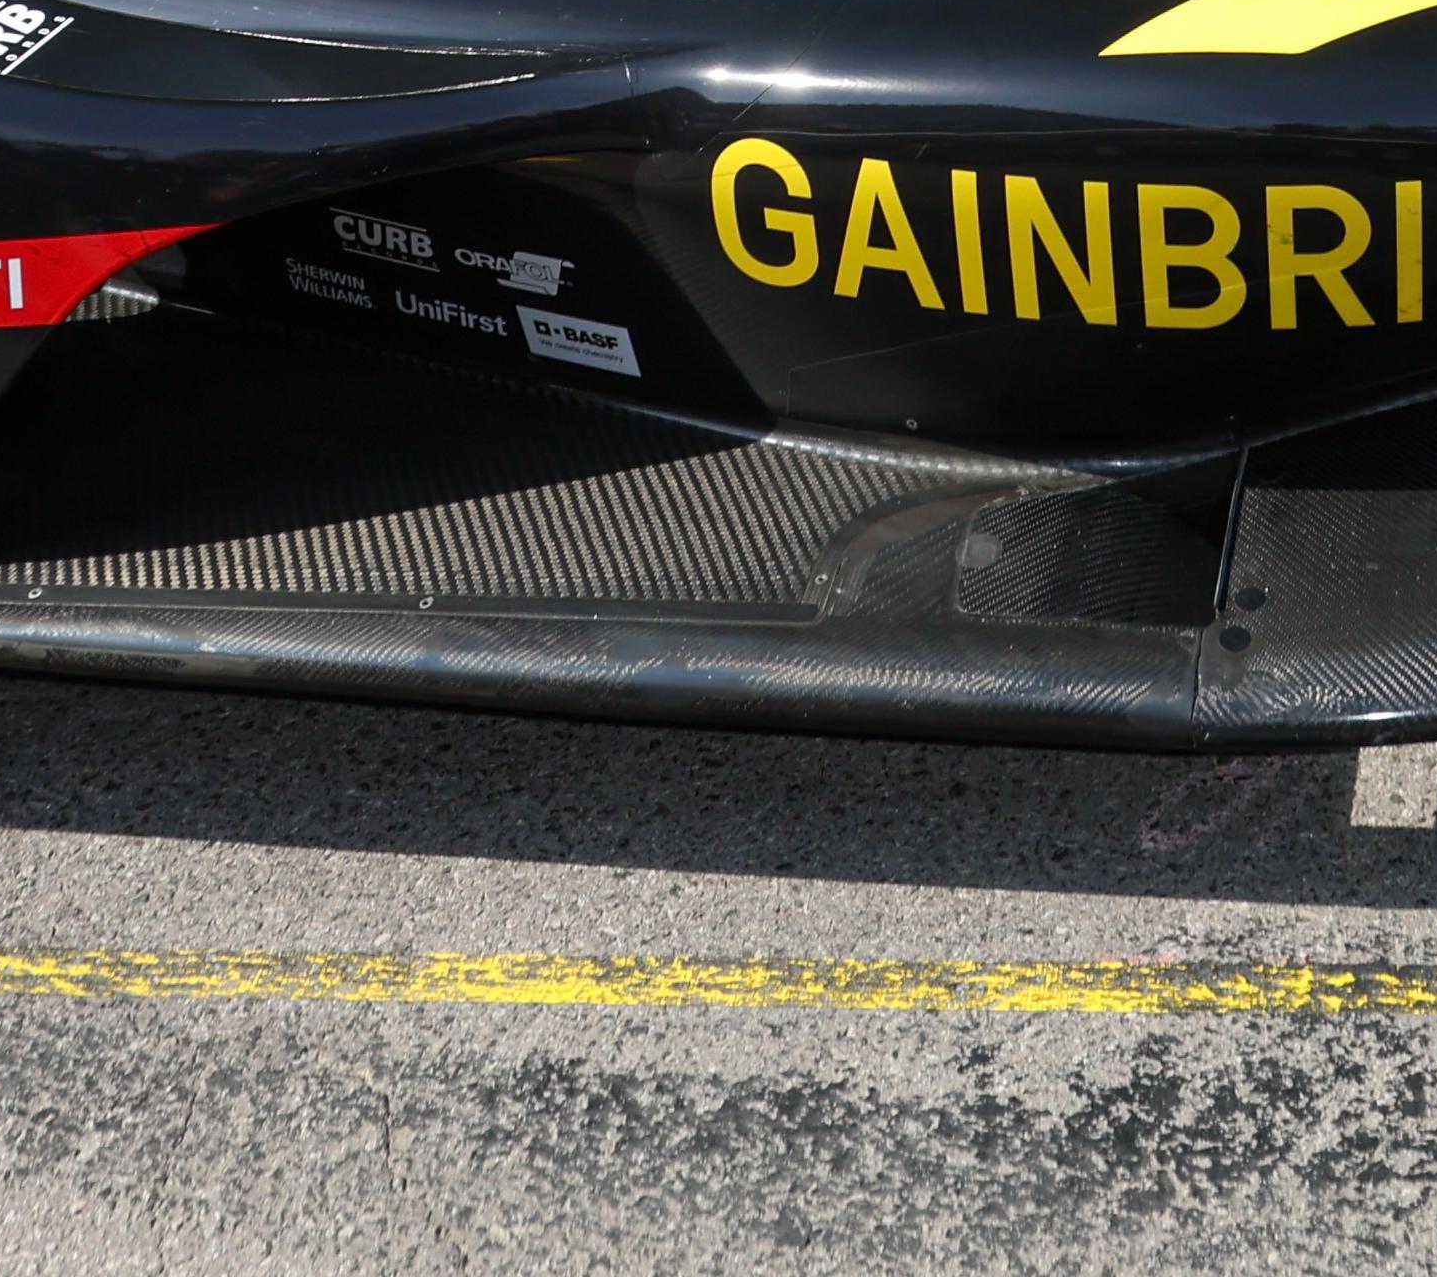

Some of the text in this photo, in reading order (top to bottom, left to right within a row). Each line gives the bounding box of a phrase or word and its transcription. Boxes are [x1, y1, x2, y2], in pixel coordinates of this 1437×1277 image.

[333, 214, 434, 259] CURB
[286, 256, 365, 291] SHERWIN
[395, 290, 508, 337] UniFirst
[563, 326, 618, 351] BASF
